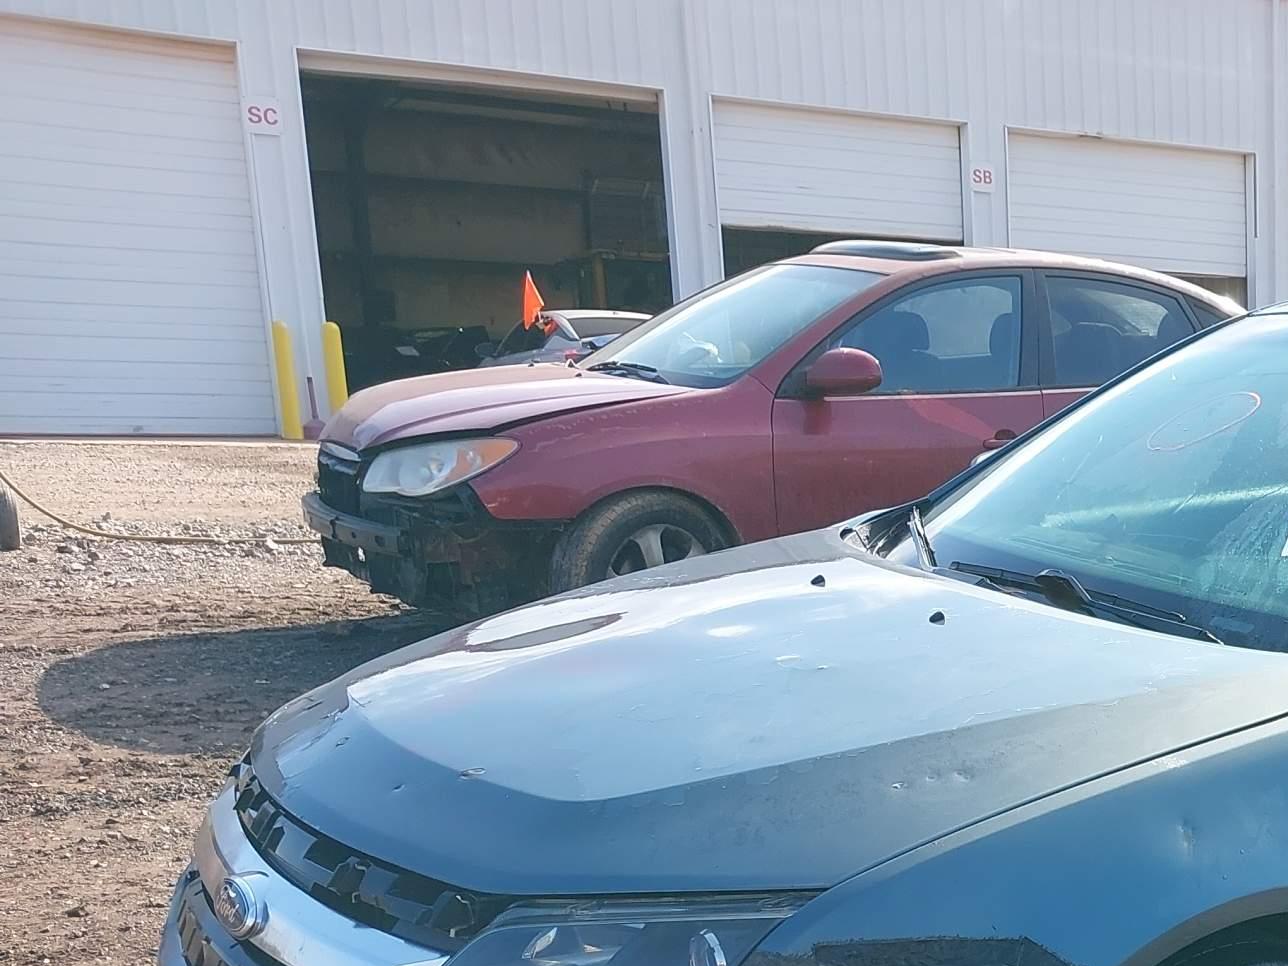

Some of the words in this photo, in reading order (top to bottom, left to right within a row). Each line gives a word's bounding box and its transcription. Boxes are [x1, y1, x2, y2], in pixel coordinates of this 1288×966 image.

[247, 106, 279, 125] SC
[972, 168, 993, 184] SB
[215, 883, 240, 924] Ford
